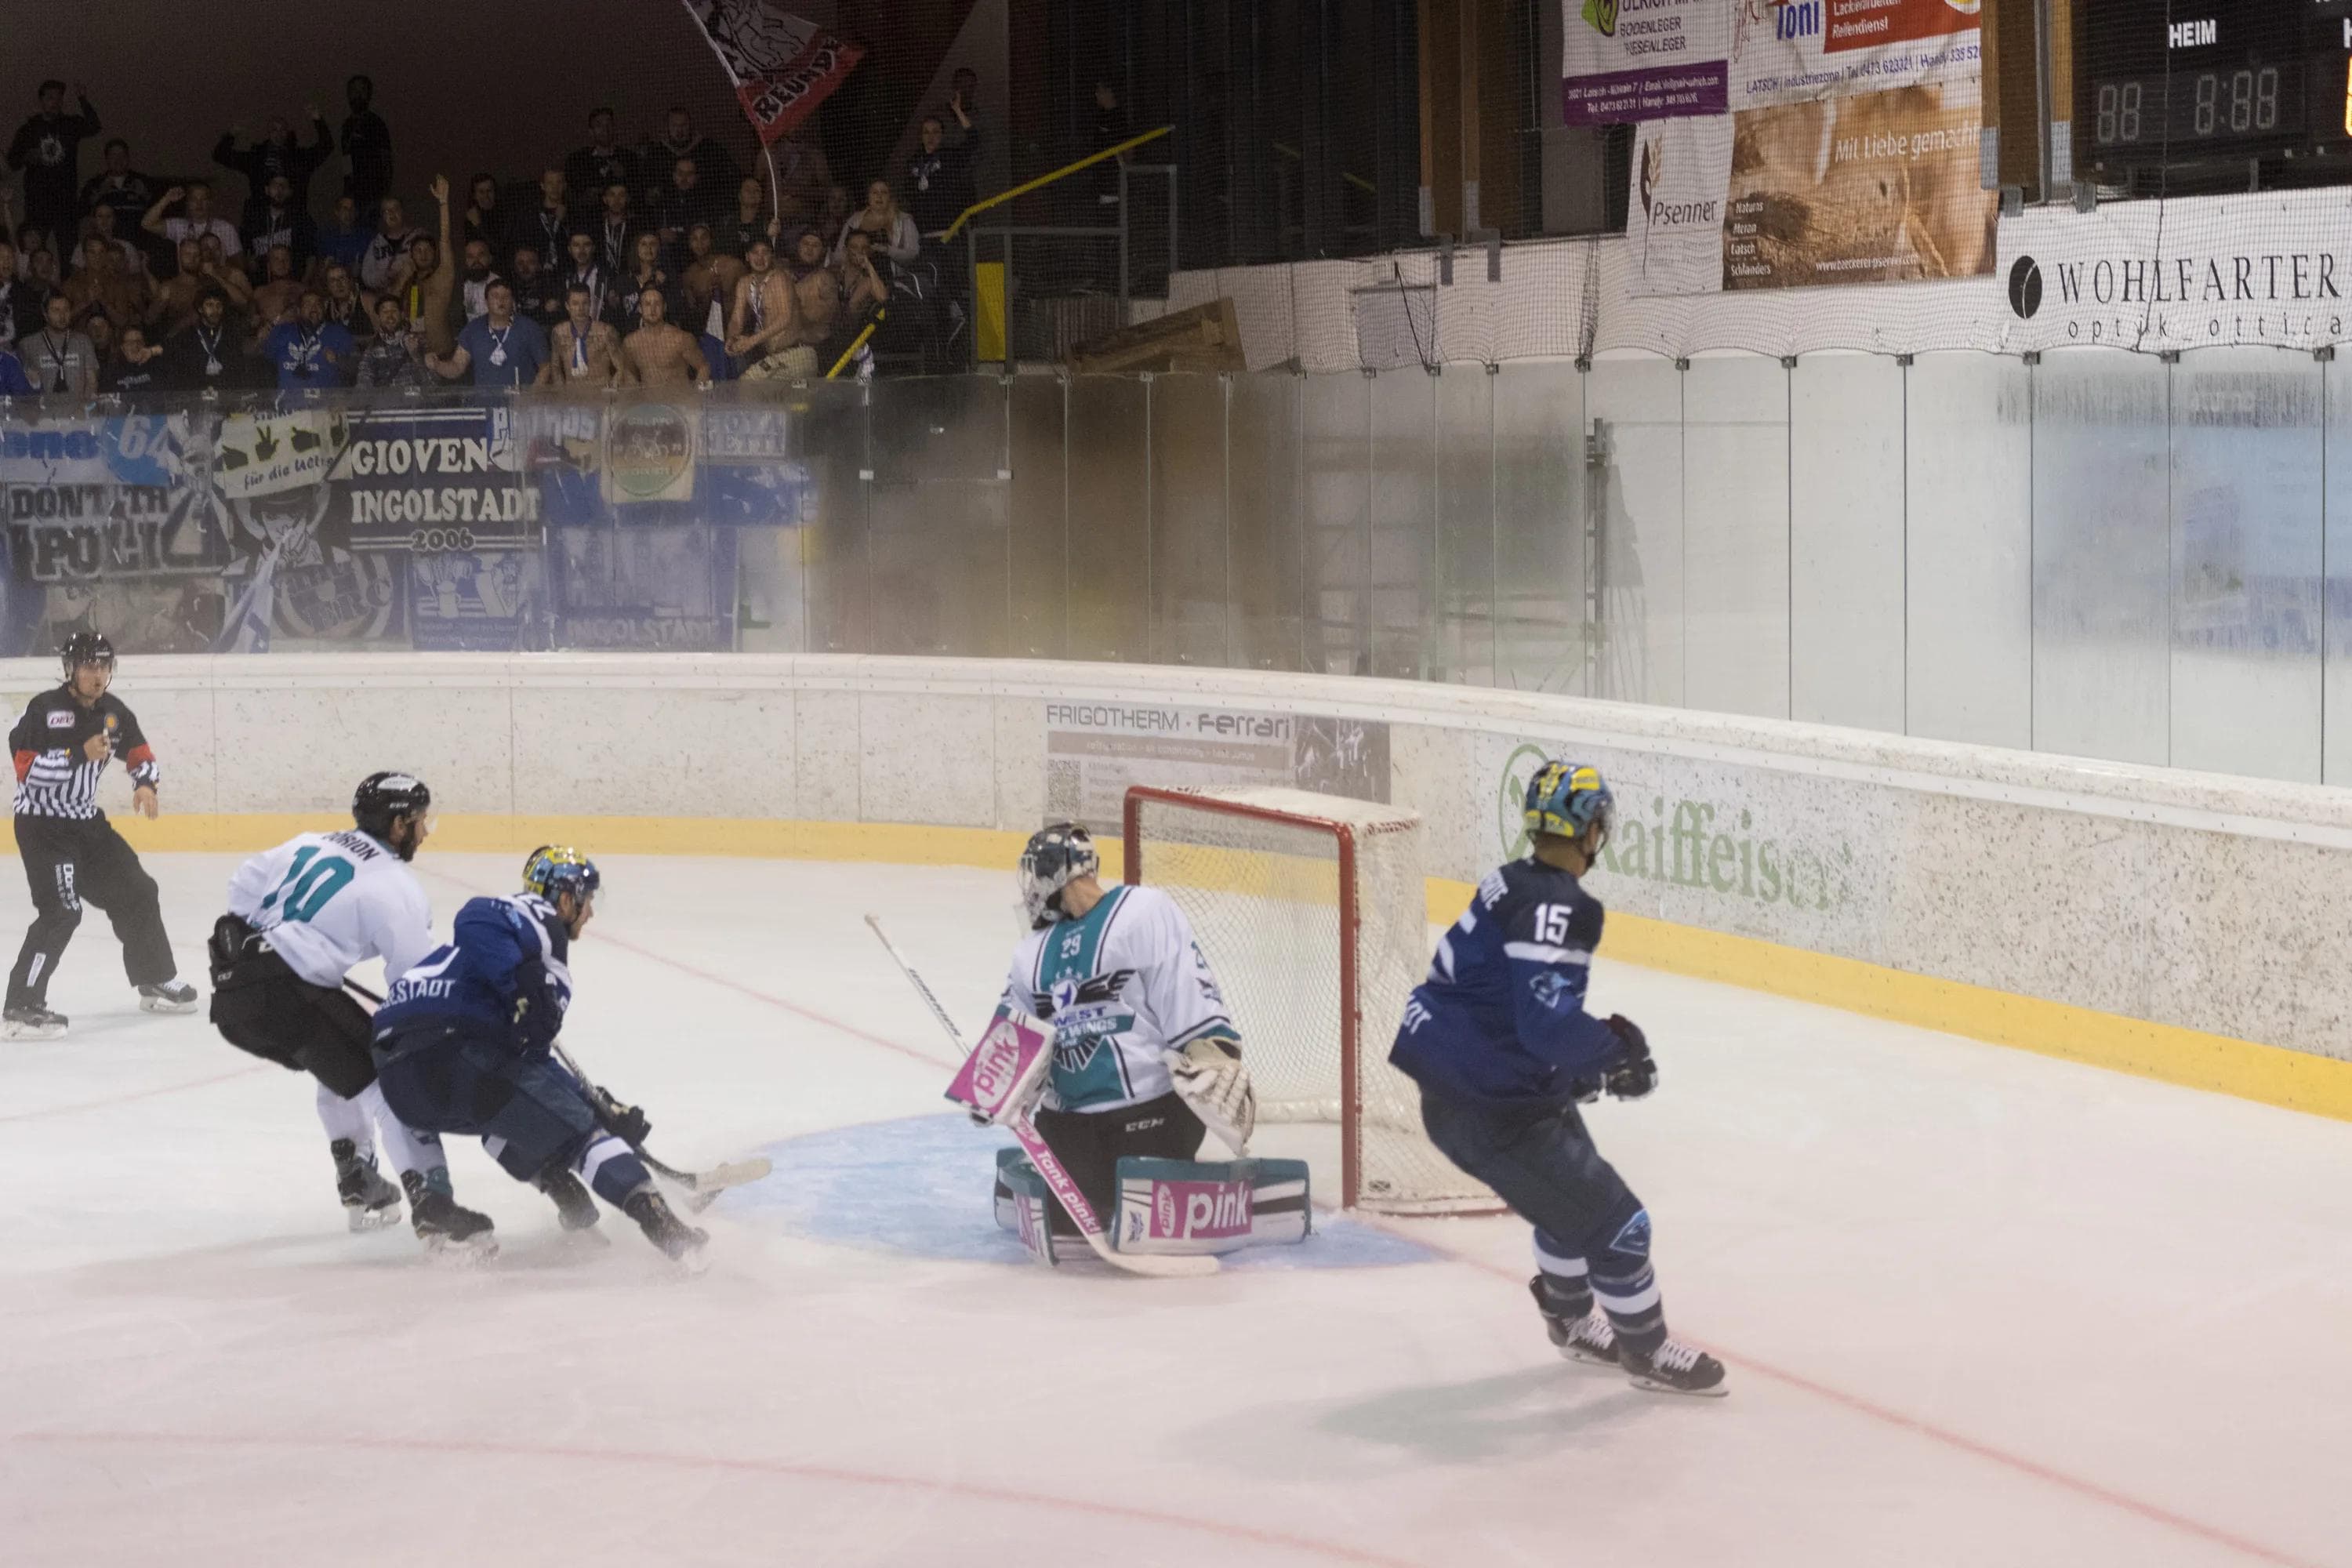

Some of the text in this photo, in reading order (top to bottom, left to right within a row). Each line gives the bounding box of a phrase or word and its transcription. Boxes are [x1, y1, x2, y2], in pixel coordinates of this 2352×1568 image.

[1620, 16, 1681, 37] BODENLEGER
[2169, 20, 2216, 49] HEIM
[1747, 78, 1778, 93] LATSCH
[1835, 136, 1859, 163] Mit
[1864, 132, 1907, 159] Liebe
[1653, 201, 1717, 226] Psenner
[1733, 222, 1757, 235] Meran
[1730, 242, 1755, 256] Latsch
[1730, 261, 1771, 277] Schlanders
[2057, 252, 2343, 305] WOHLFARTER
[352, 437, 488, 475] GIOVEN
[351, 487, 540, 524] INGOLSTADT
[410, 527, 476, 553] 2006
[1047, 705, 1290, 739] FRIGOTHERM Ferrari
[261, 846, 355, 924] 10
[1534, 903, 1573, 946] 15
[1061, 934, 1082, 959] 29
[1054, 1006, 1107, 1026] WEST
[975, 1037, 1018, 1097] pink
[1037, 1149, 1069, 1189] Tank
[1182, 1181, 1249, 1240] pink
